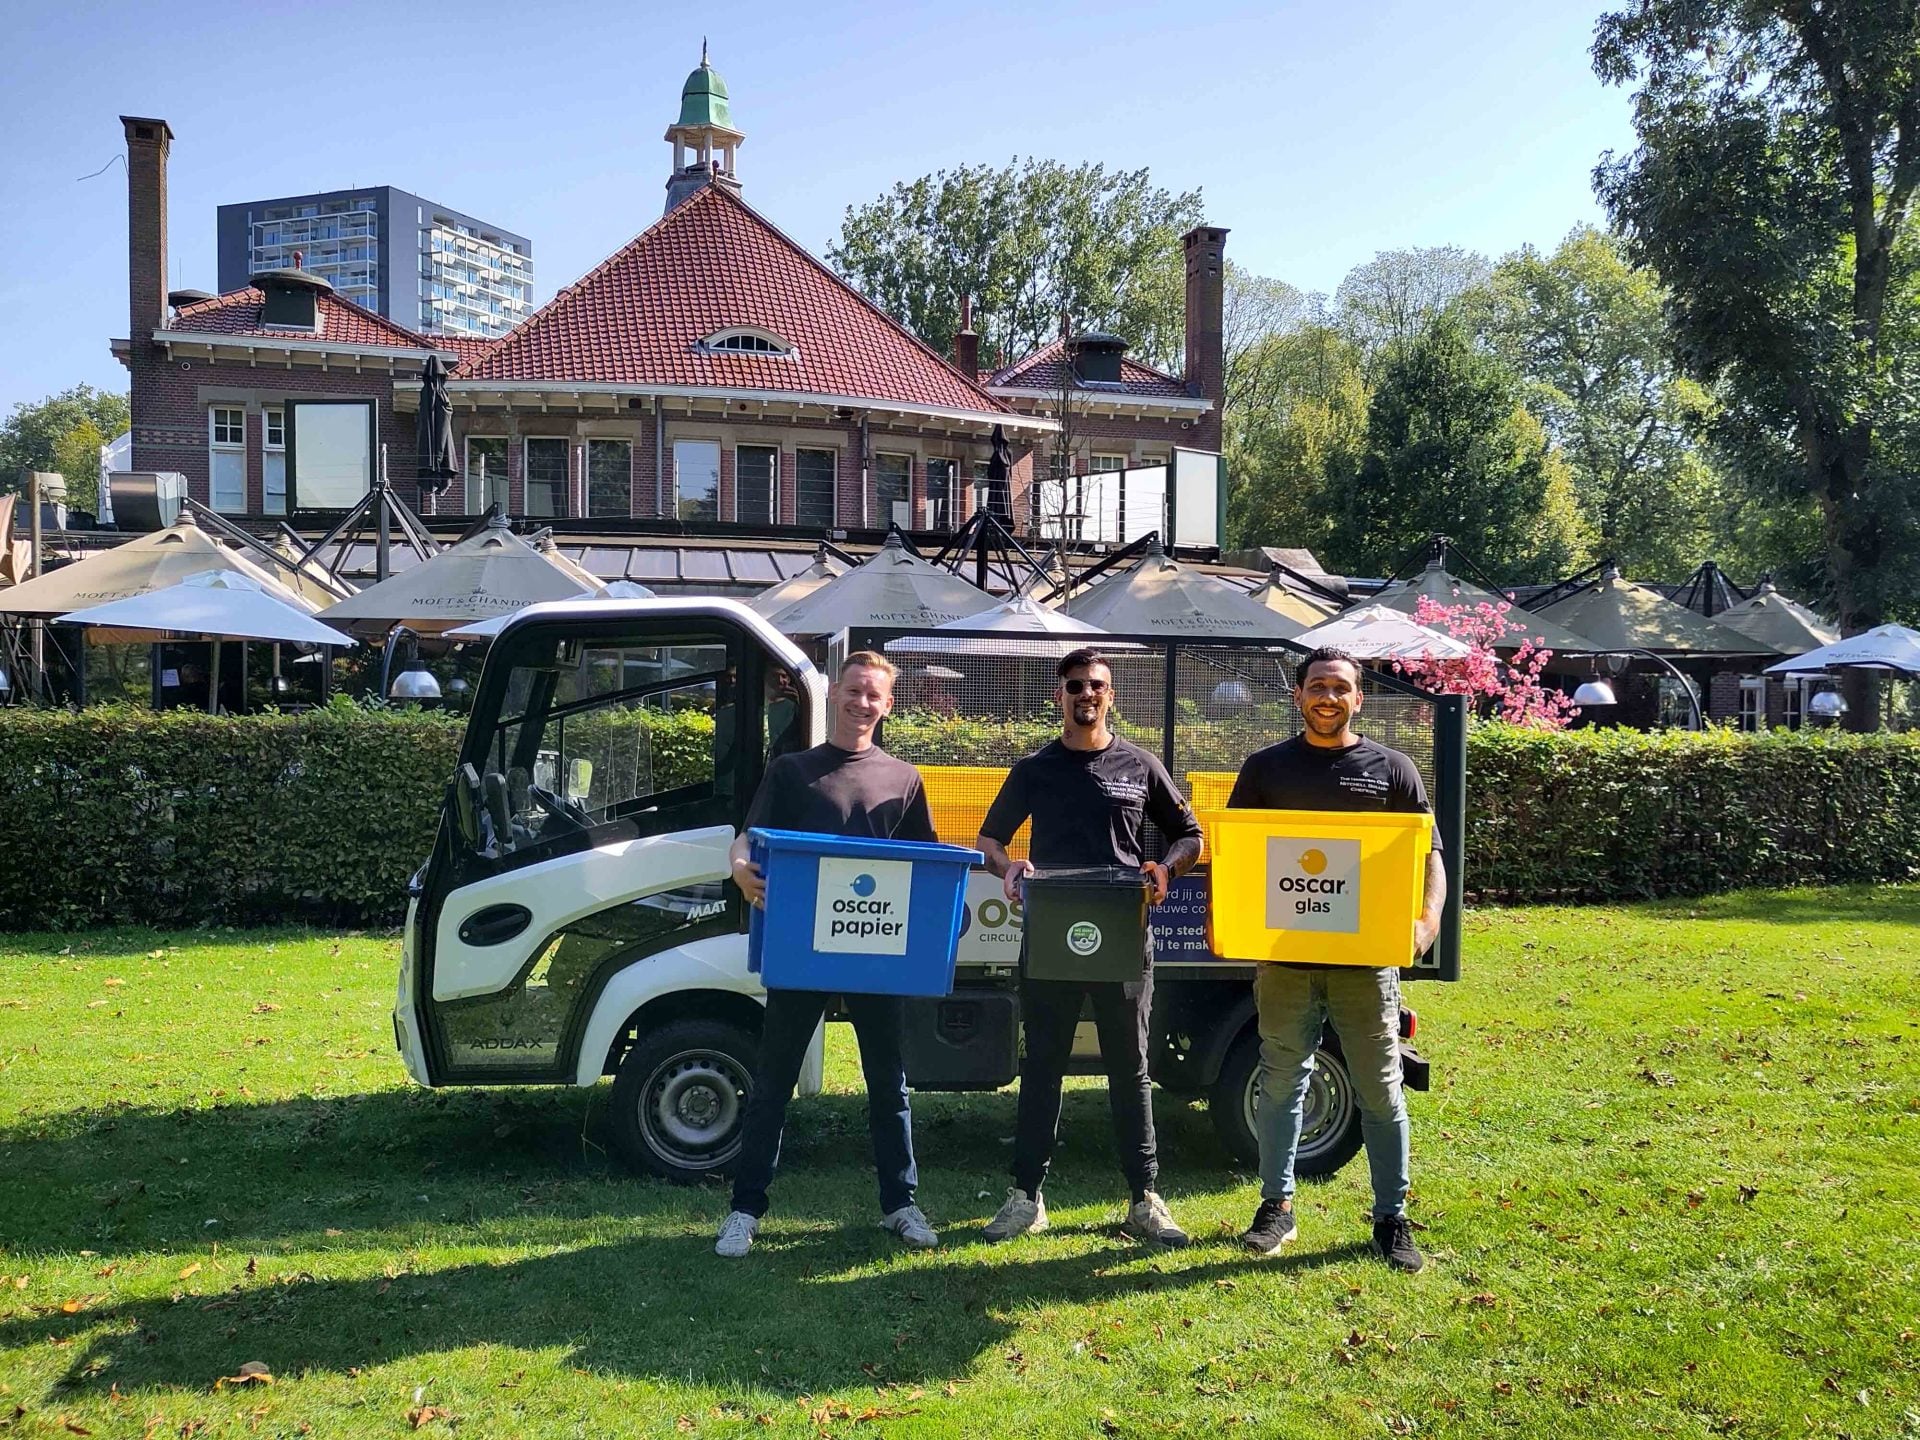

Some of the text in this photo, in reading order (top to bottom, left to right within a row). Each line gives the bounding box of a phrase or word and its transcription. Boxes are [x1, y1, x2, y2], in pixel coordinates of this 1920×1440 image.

[468, 595, 536, 607] CHANDO
[920, 610, 969, 621] CHAND
[1166, 888, 1179, 900] rd
[1182, 888, 1192, 901] jij
[686, 899, 727, 921] MAAT
[1191, 905, 1207, 914] co
[1294, 897, 1331, 915] glas
[977, 898, 1024, 929] OS
[831, 917, 904, 938] papier
[1153, 925, 1174, 937] elp
[979, 933, 1020, 943] CIRCUL
[1167, 940, 1180, 950] te
[1183, 940, 1209, 950] mak
[470, 1037, 543, 1050] ADDAX
